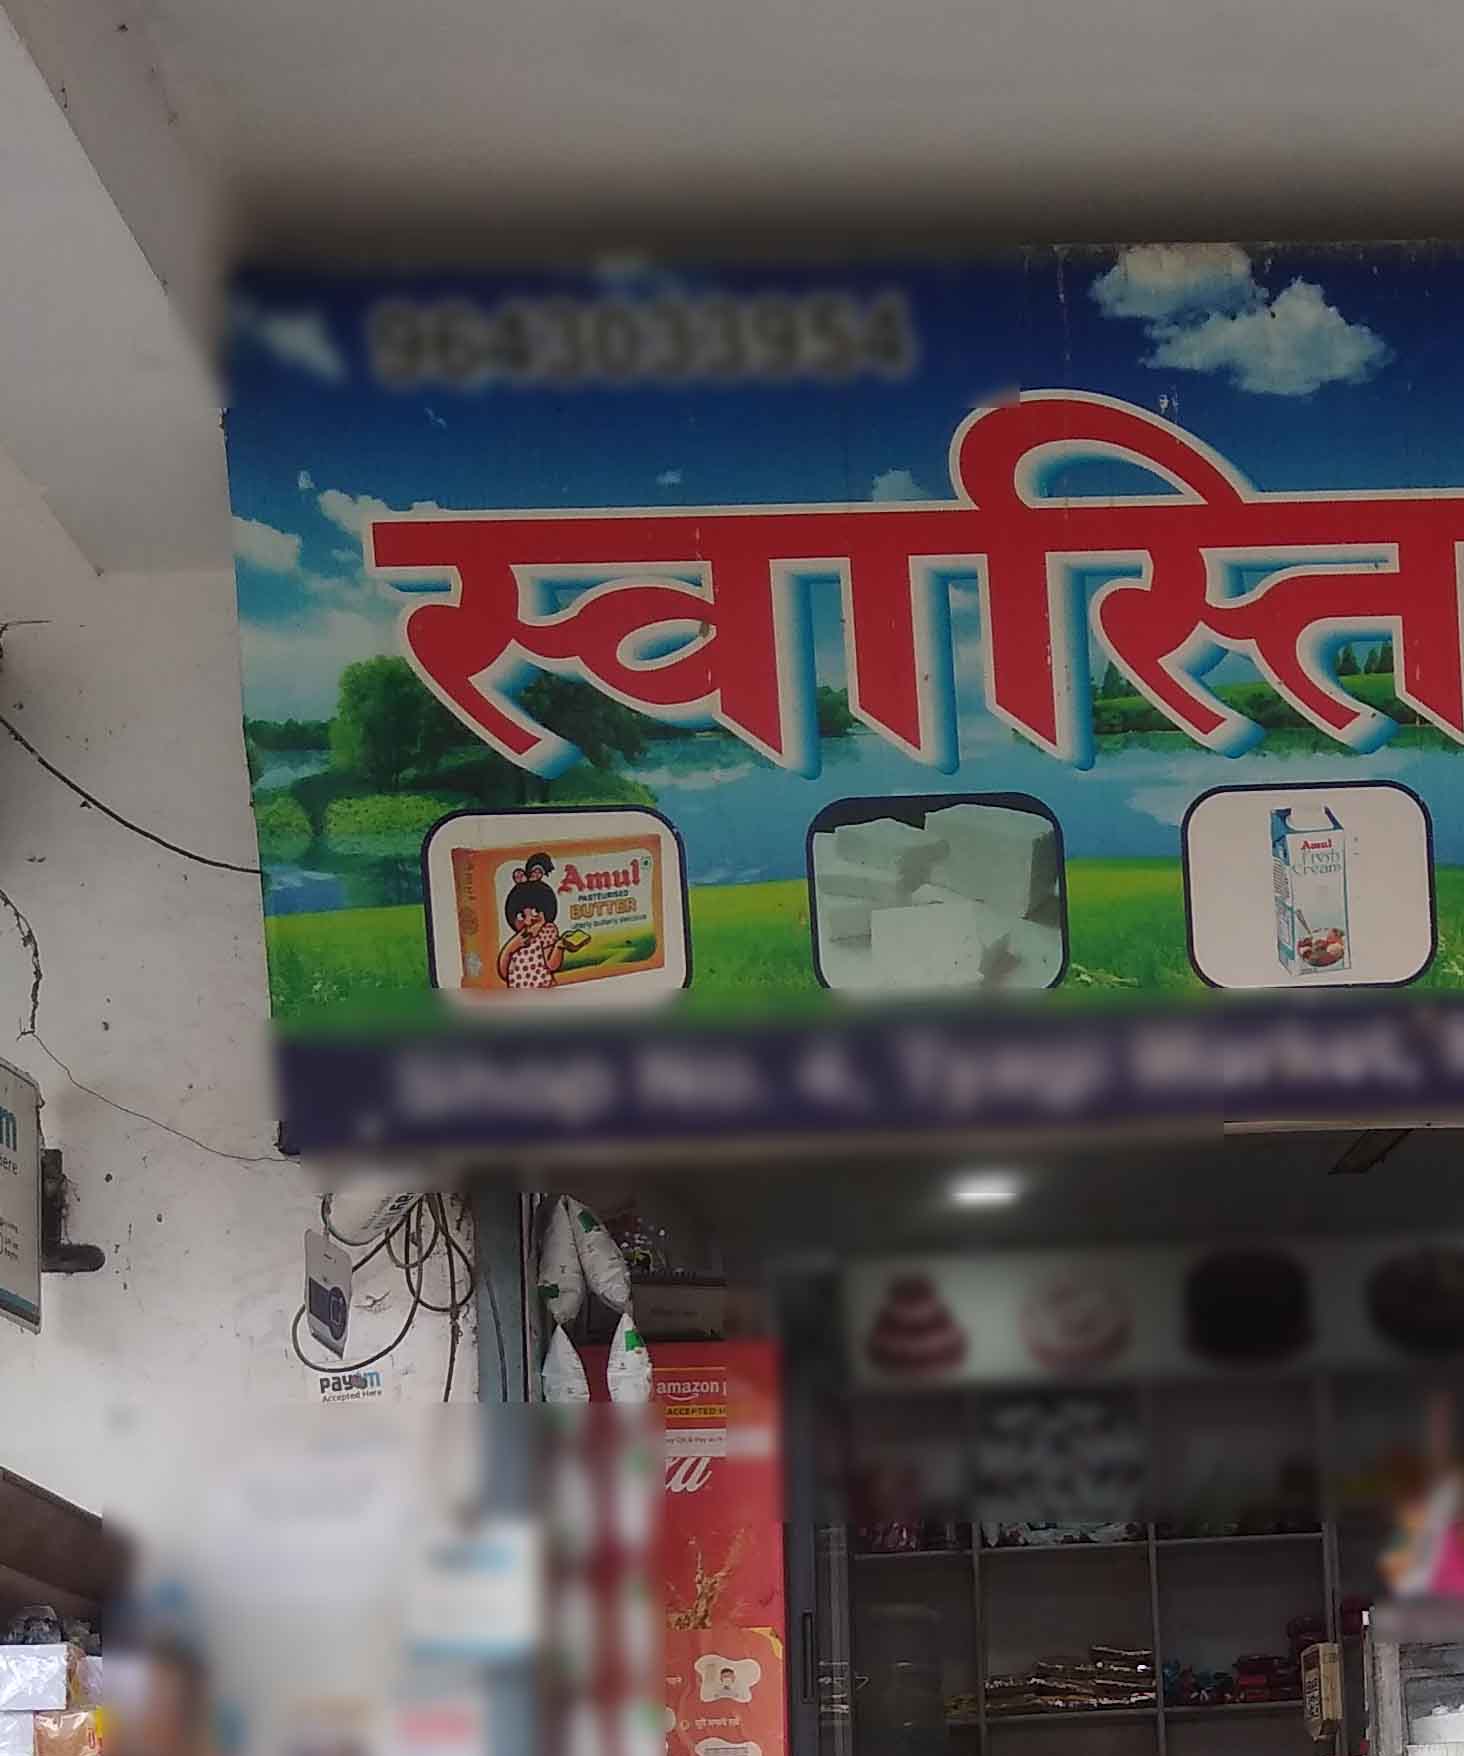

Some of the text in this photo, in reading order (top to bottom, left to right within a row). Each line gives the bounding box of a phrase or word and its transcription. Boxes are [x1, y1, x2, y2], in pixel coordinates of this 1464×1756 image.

[1300, 838, 1333, 851] Amul
[557, 858, 641, 895] Amul
[569, 896, 638, 920] BUTTER
[656, 1381, 720, 1400] amazon
